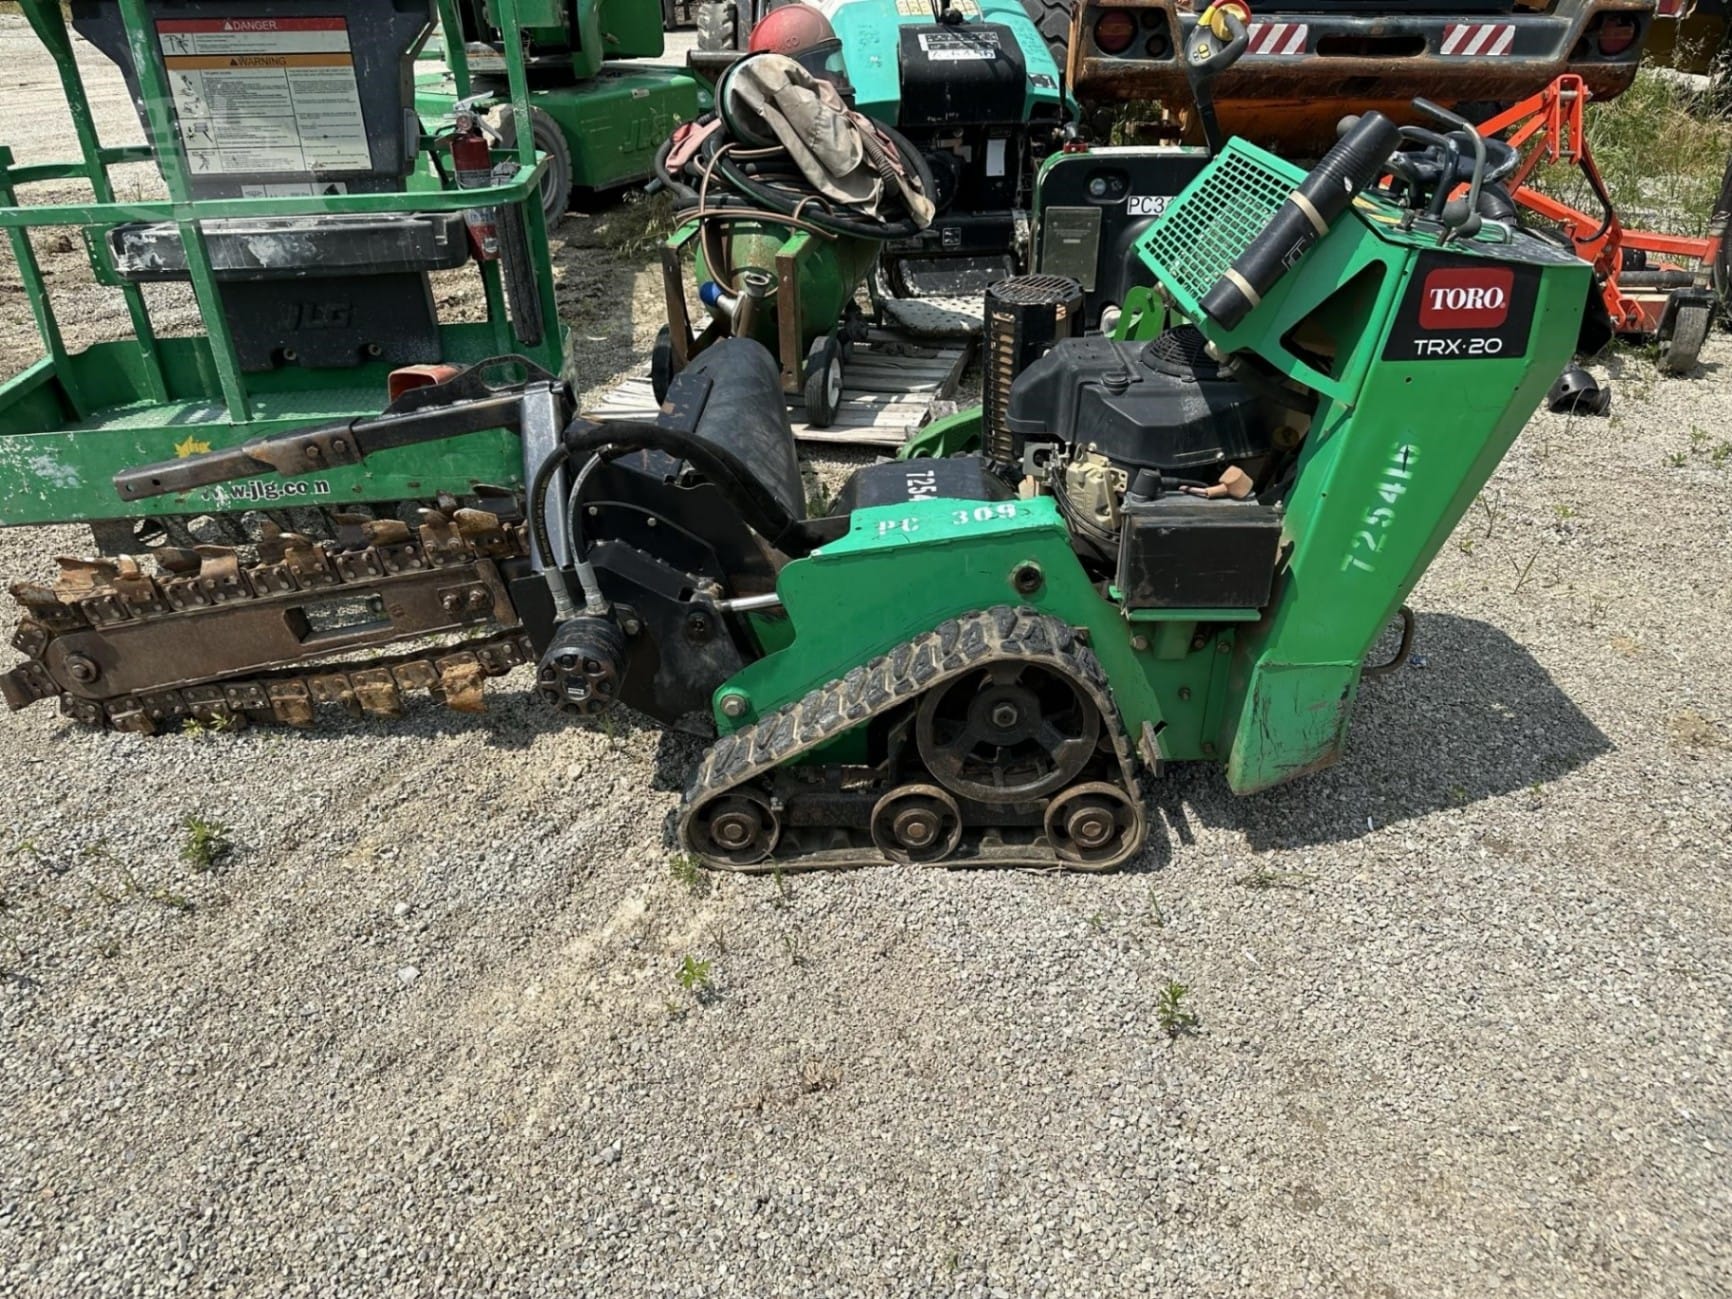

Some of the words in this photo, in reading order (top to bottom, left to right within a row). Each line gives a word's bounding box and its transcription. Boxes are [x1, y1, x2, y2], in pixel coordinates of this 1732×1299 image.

[233, 20, 278, 31] DANGER
[238, 56, 287, 66] WARNING
[1128, 196, 1176, 214] PC3
[1430, 287, 1504, 310] TORO
[878, 517, 919, 536] PC
[952, 503, 1016, 526] 309
